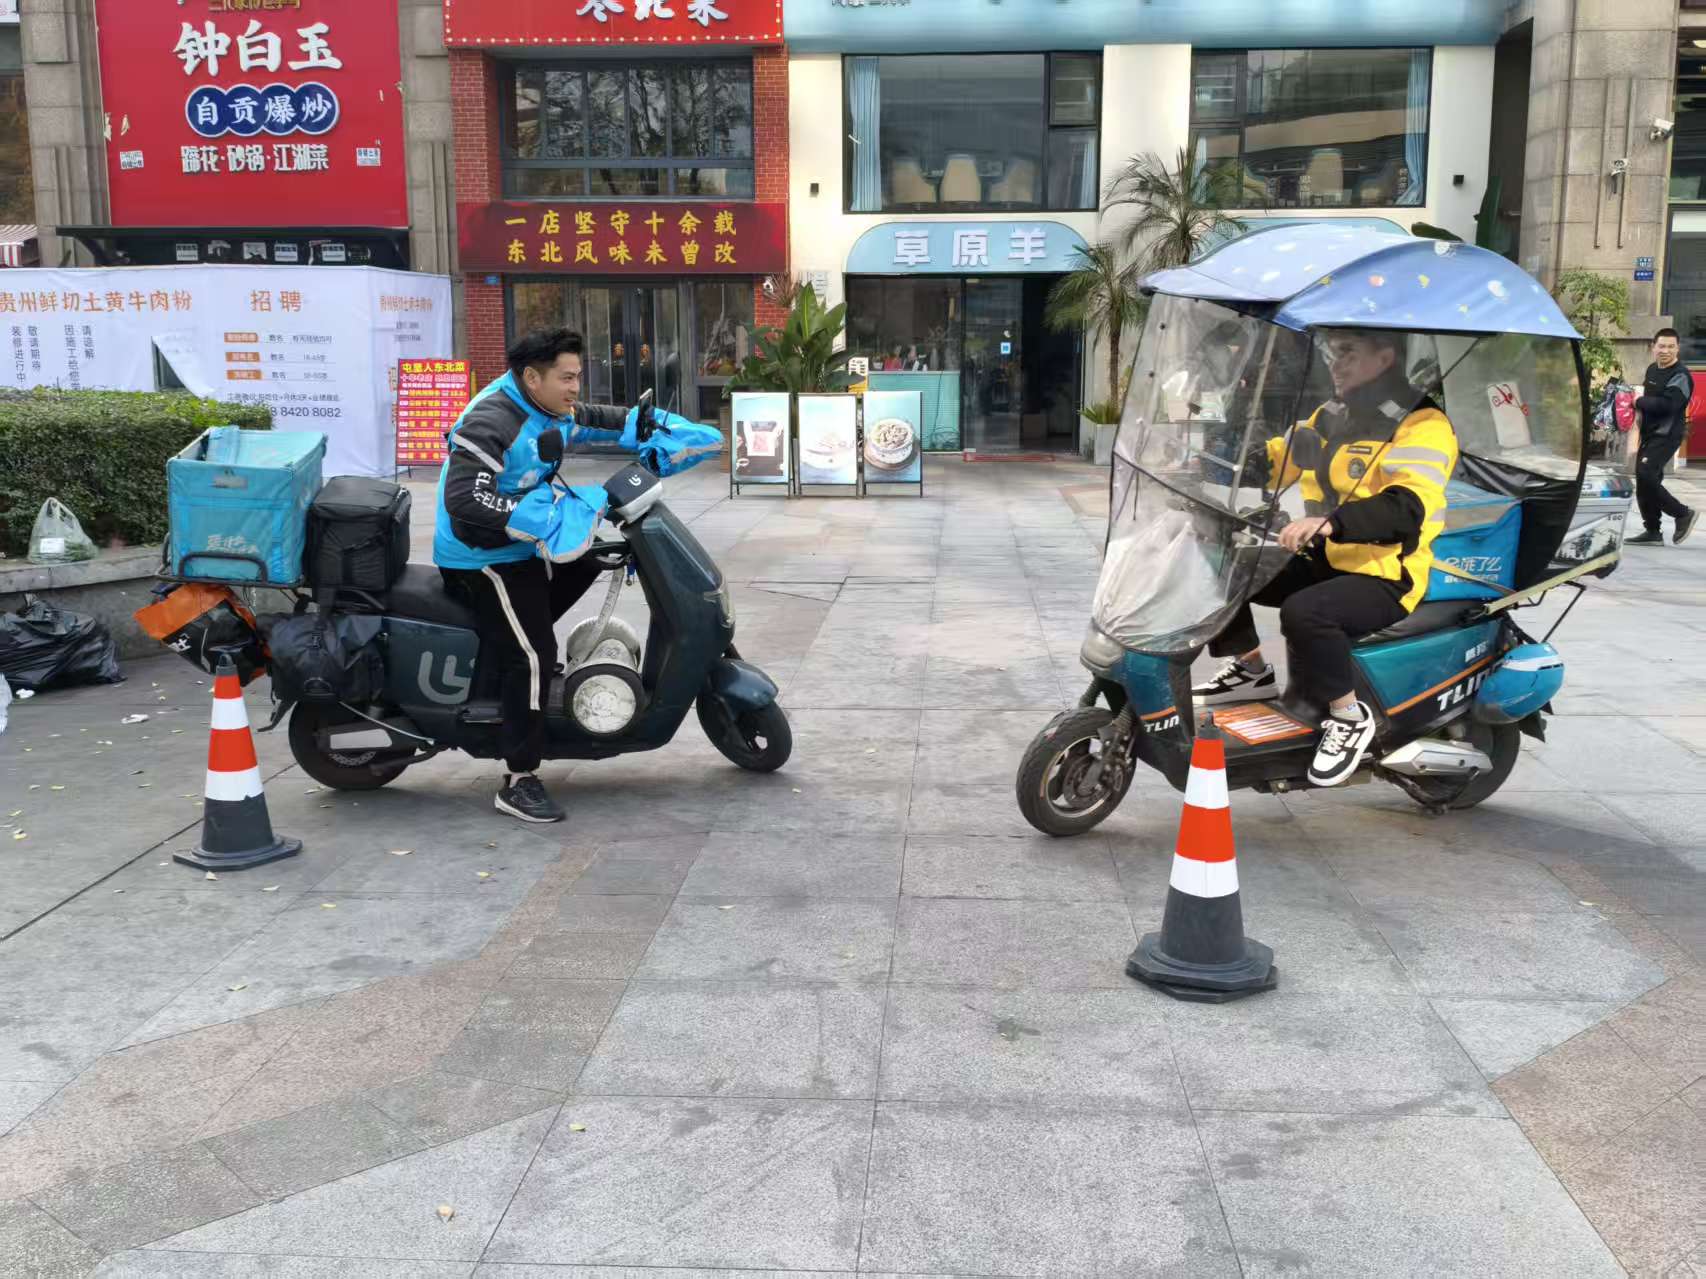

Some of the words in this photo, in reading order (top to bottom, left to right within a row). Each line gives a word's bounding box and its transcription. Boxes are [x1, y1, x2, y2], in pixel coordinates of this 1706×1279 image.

[172, 19, 343, 77] 钟白玉
[195, 94, 332, 127] 自贡爆炒
[503, 209, 738, 236] 一店坚守十余载
[505, 240, 738, 266] 东北风味未曾改
[892, 227, 1048, 268] 草原羊
[0, 291, 193, 312] 贵州鲜切土黄牛肉粉
[250, 290, 302, 312] 招聘
[280, 406, 310, 418] 8420
[311, 406, 342, 418] 8082
